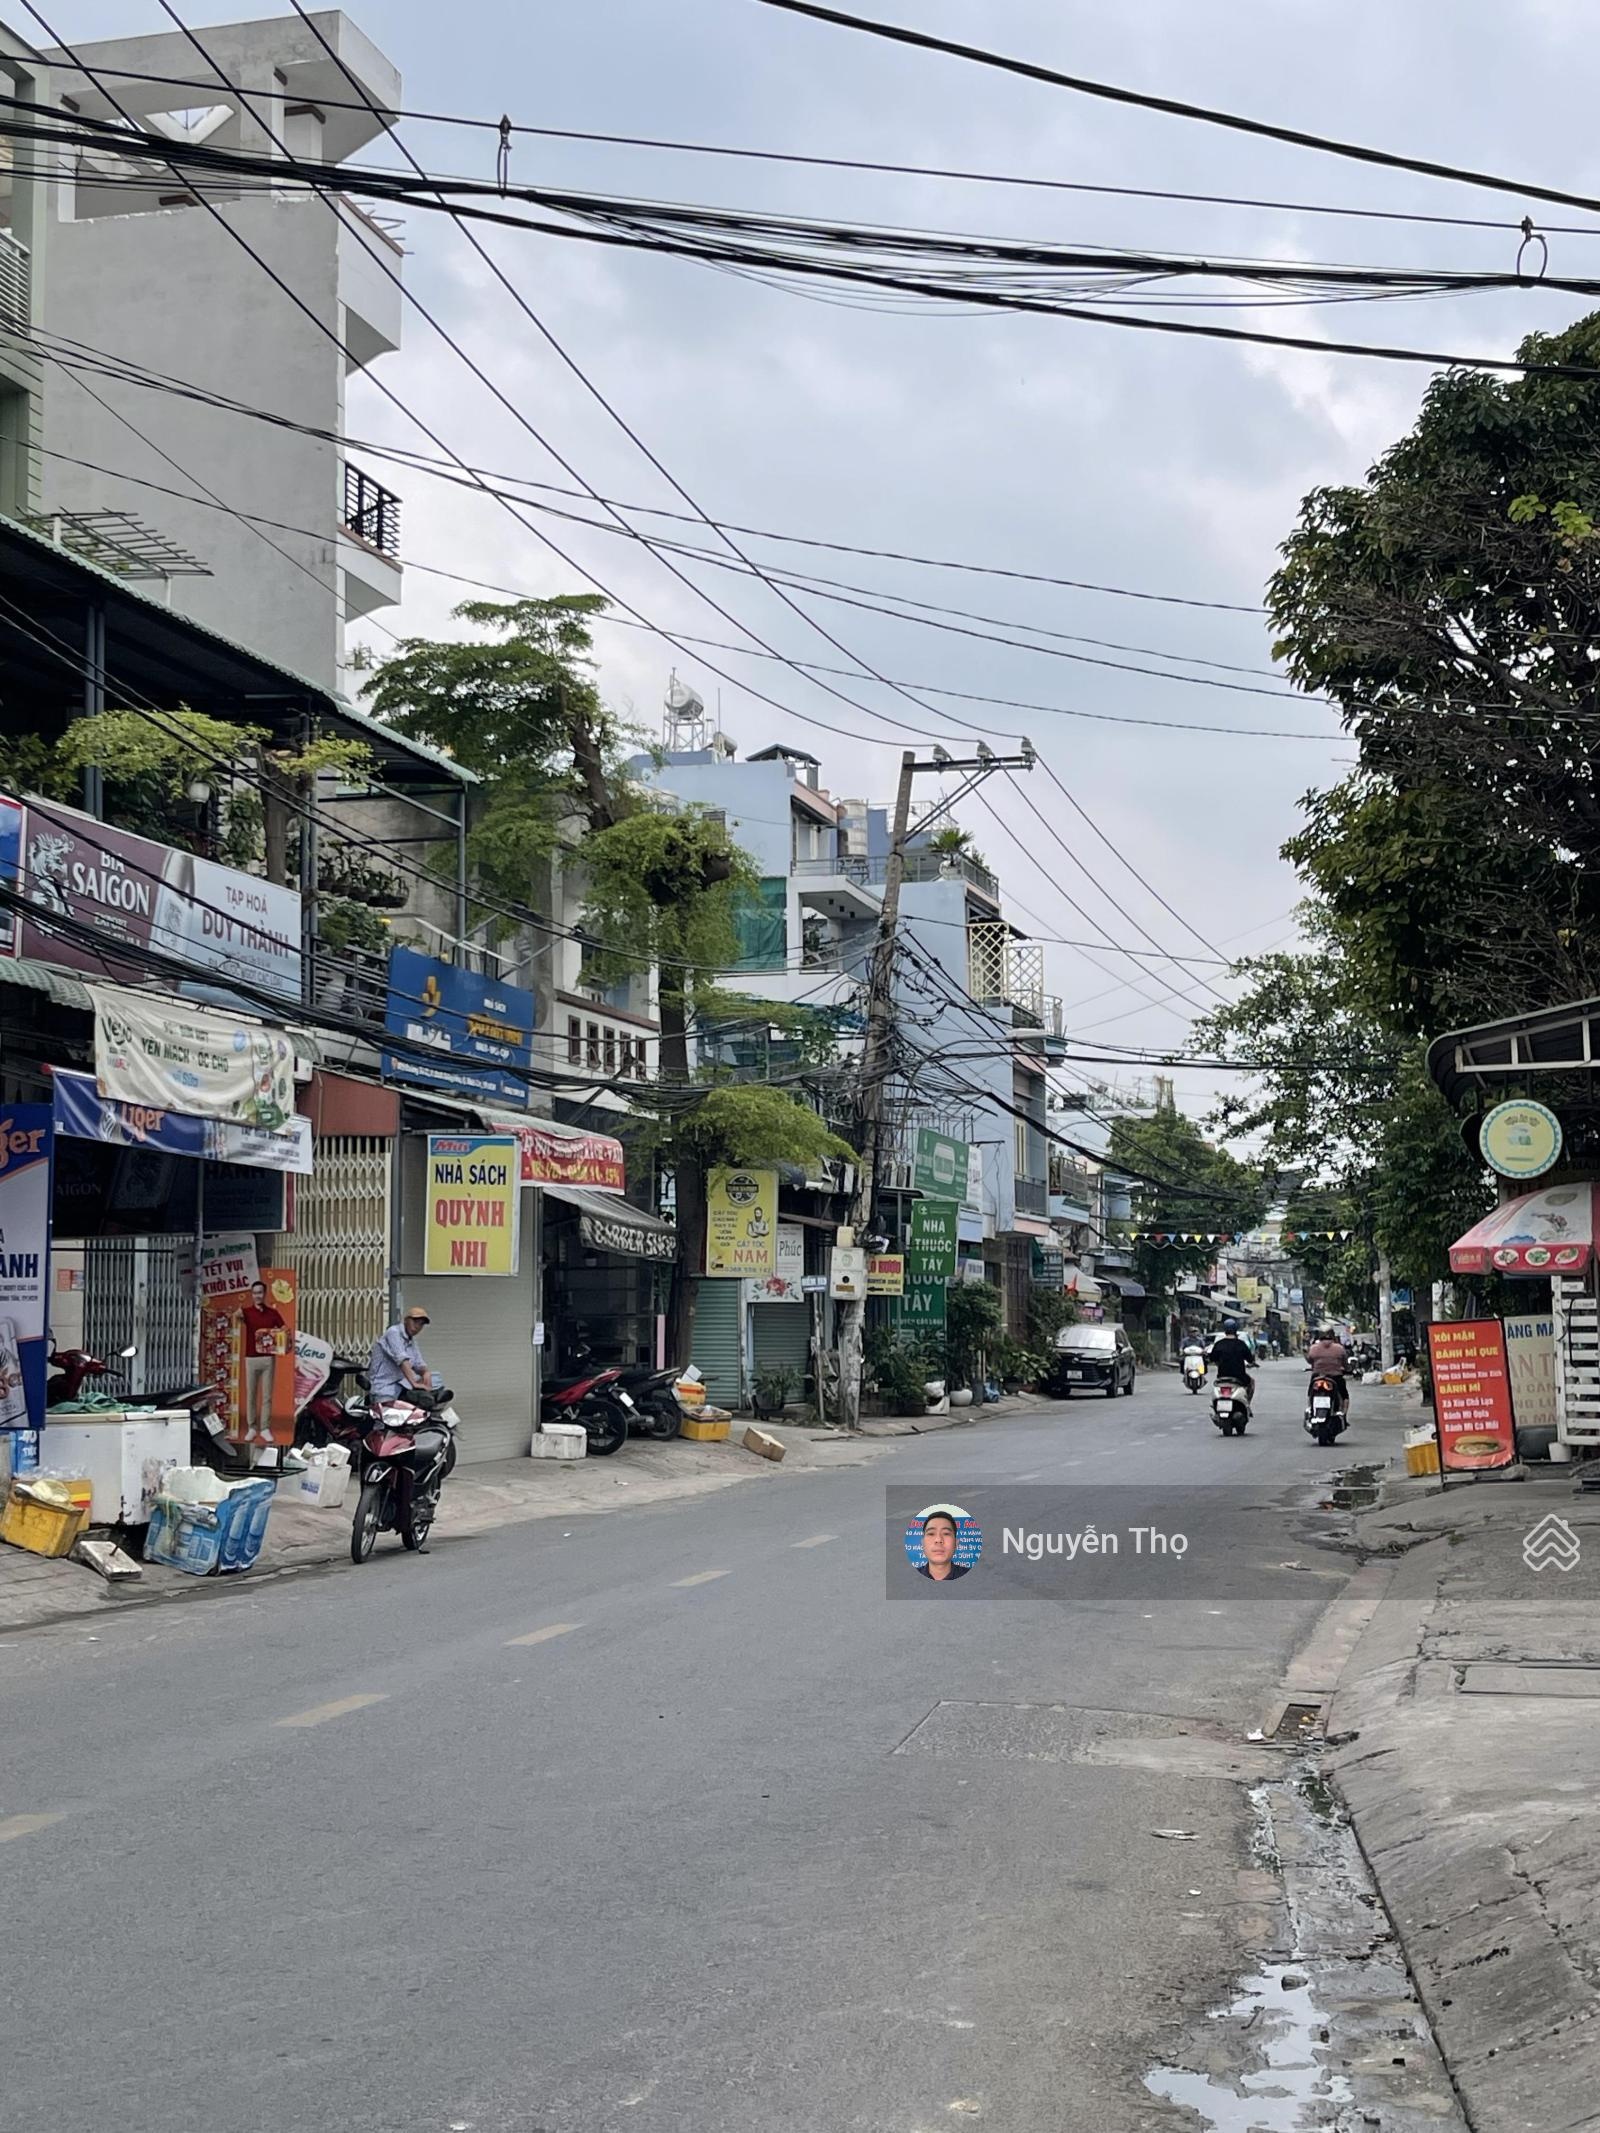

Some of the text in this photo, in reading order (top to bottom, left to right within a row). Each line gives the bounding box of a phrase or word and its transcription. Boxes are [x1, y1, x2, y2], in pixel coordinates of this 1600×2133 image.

[72, 862, 150, 916] SAIGON
[202, 909, 234, 942] DUY
[435, 1158, 463, 1184] NHÀ
[468, 1159, 507, 1186] SÁCH
[435, 1192, 505, 1228] QUỲNH
[922, 1217, 946, 1233] NHÀ
[450, 1240, 488, 1268] NHI
[778, 1239, 802, 1258] Phúc
[914, 1237, 952, 1253] THUỐC
[226, 1260, 245, 1273] VUI
[733, 1249, 769, 1264] NAM
[921, 1257, 943, 1271] TÂY
[902, 1290, 933, 1312] TÂY
